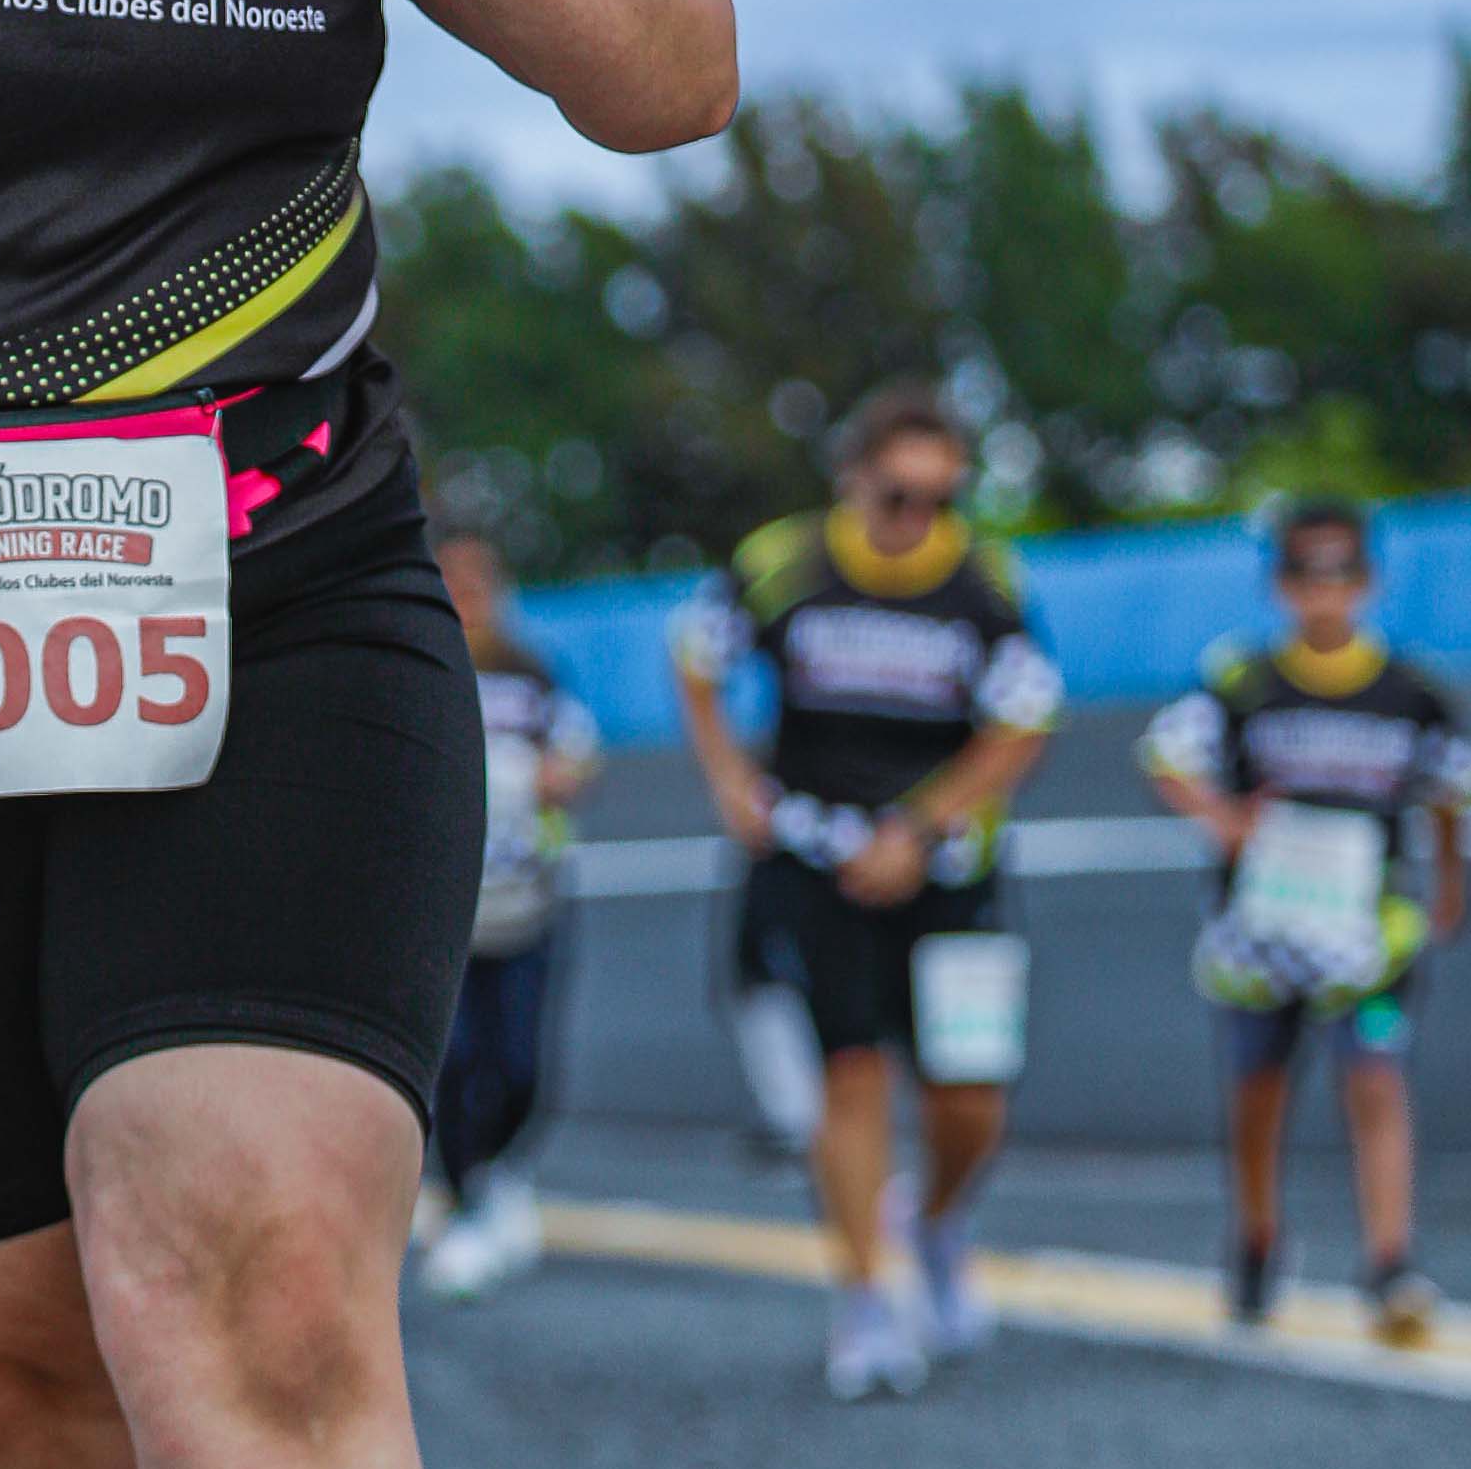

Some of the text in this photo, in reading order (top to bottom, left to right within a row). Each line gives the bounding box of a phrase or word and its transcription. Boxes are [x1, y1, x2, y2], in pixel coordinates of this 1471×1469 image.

[59, 531, 128, 561] RACE
[24, 573, 77, 590] Clubes
[80, 572, 104, 588] del
[107, 572, 174, 588] Noroeste
